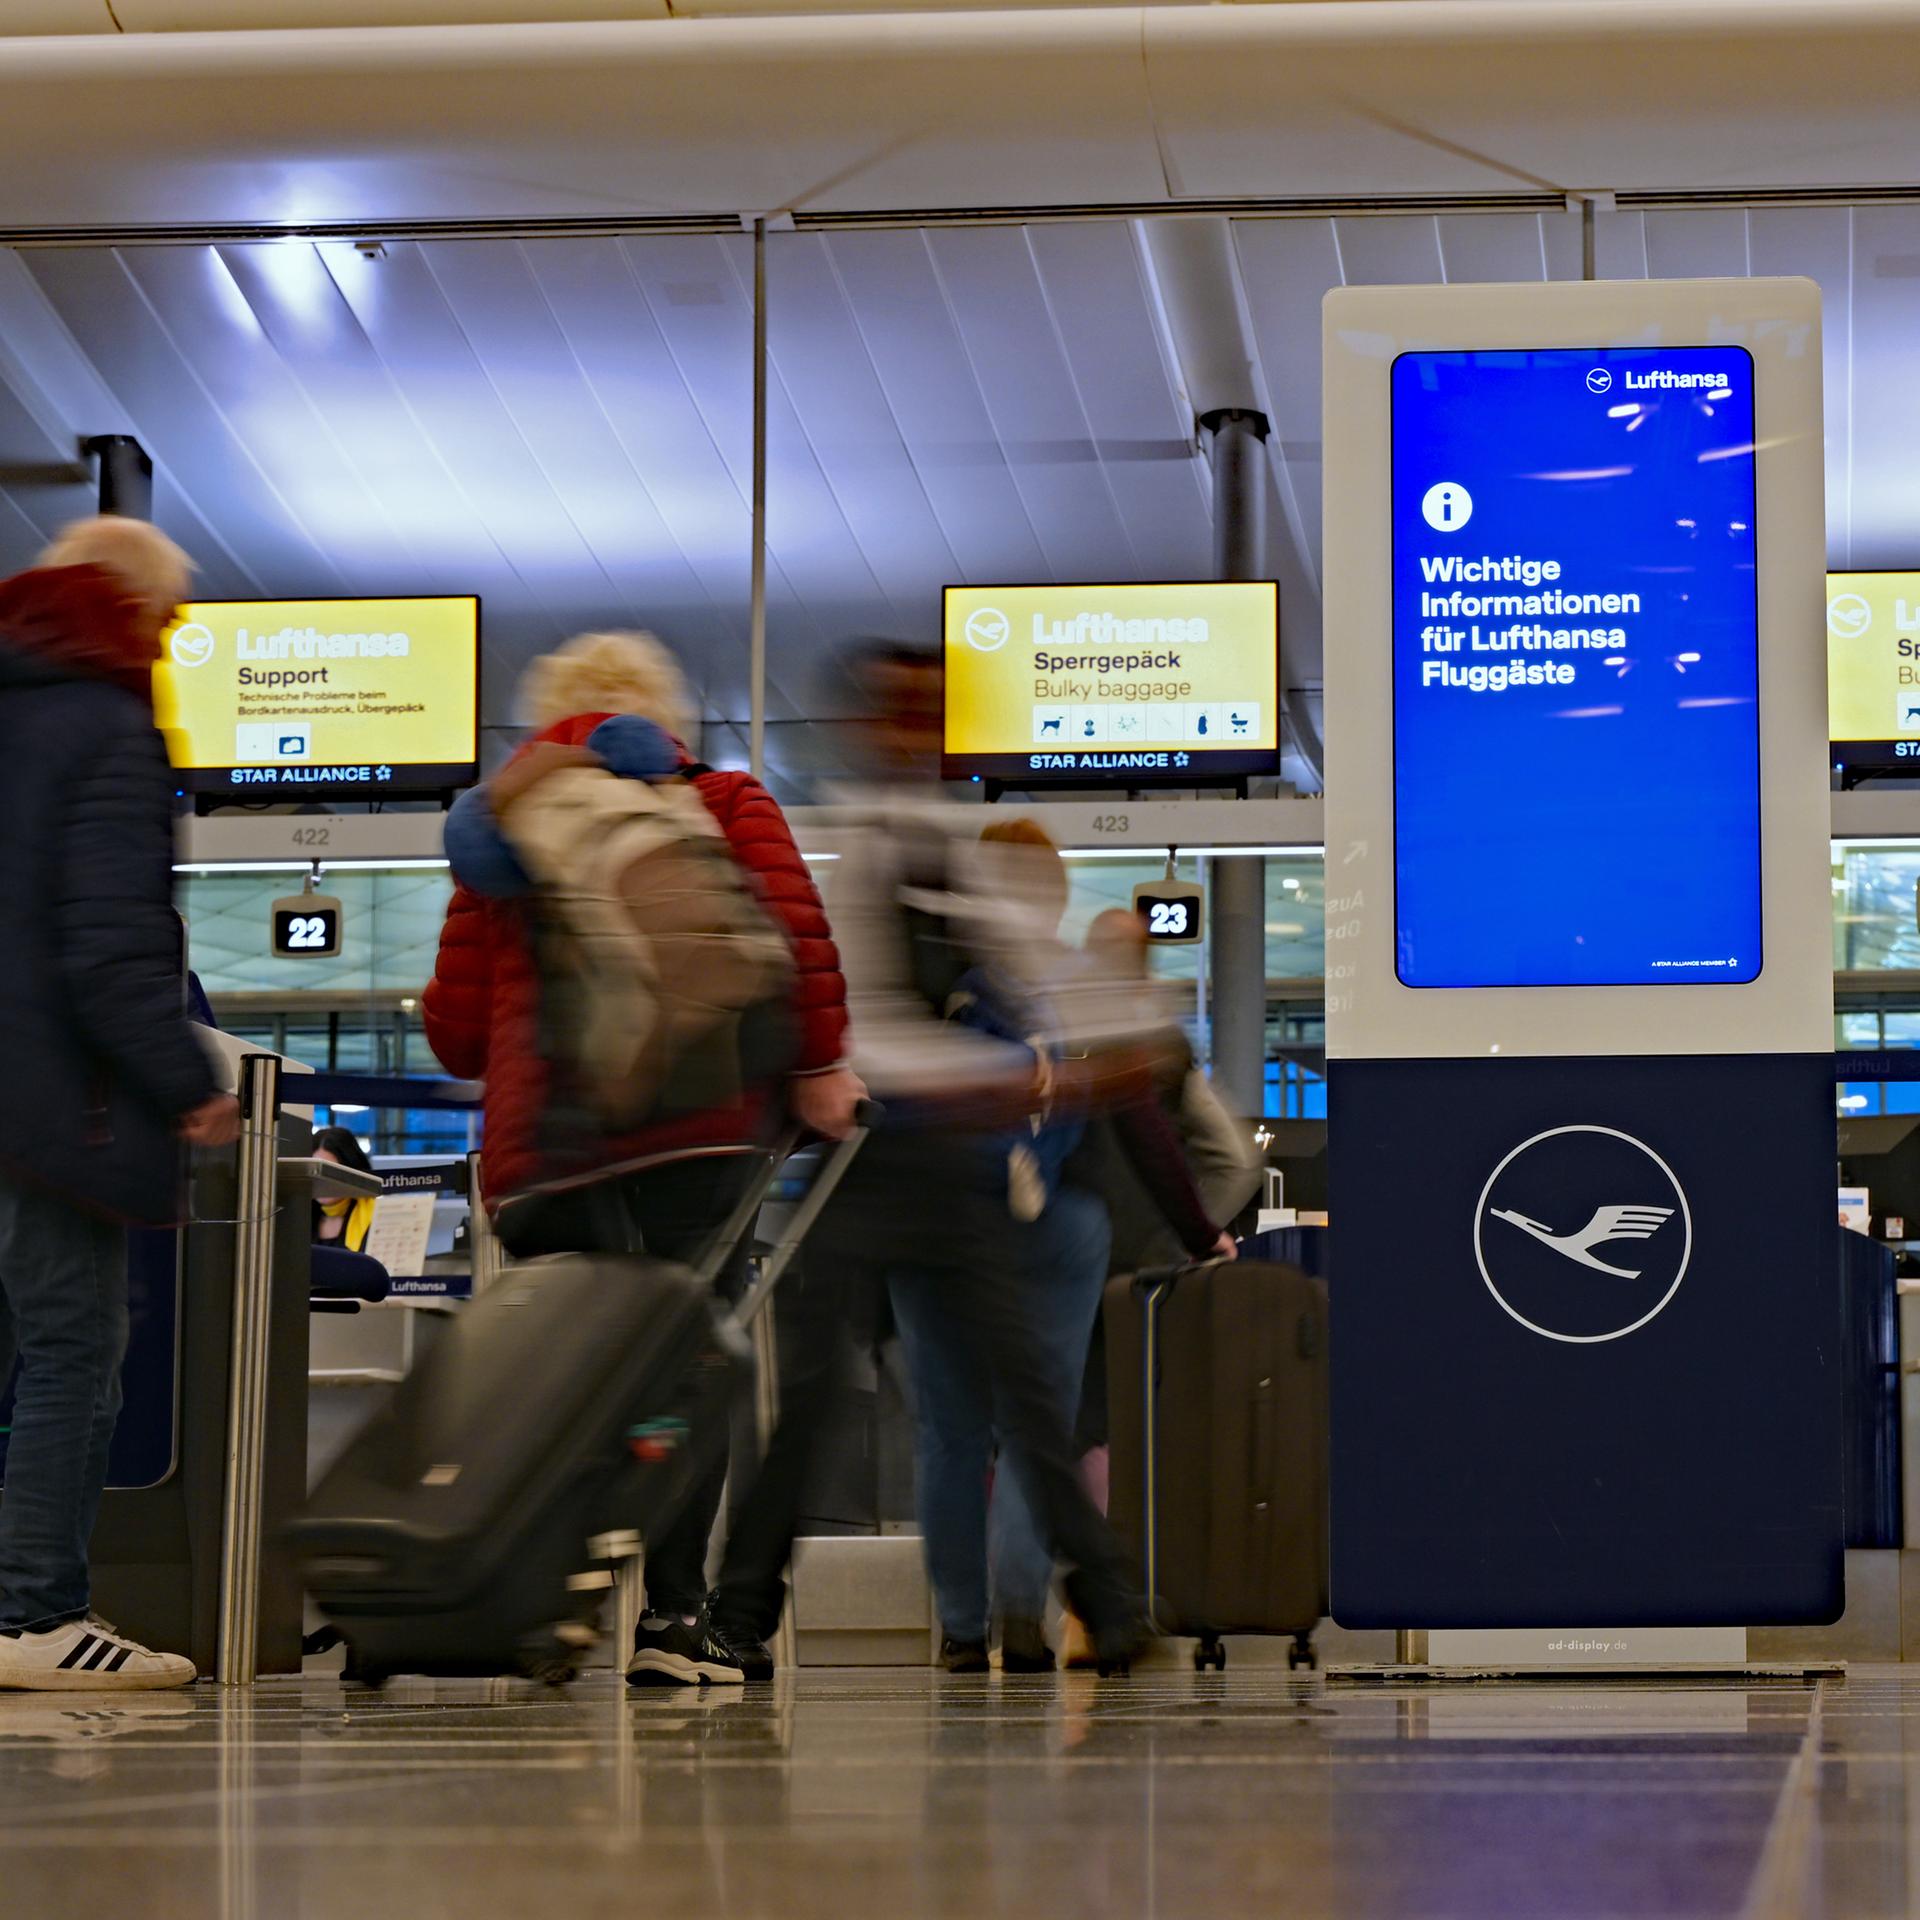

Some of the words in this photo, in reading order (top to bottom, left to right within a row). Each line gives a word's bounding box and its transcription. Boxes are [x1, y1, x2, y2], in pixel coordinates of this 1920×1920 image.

[1626, 370, 1728, 389] Lufthansa
[1420, 556, 1561, 586] Wichtige
[1421, 589, 1640, 617] Informationen
[1032, 612, 1209, 645] Lufthansa
[1421, 626, 1465, 652] für
[1472, 625, 1626, 651] Lufthansa
[236, 627, 410, 660] Lufthansa
[1034, 649, 1181, 674] Sperrgepäck
[238, 667, 329, 688] Support
[1422, 659, 1576, 692] Fluggäste
[238, 692, 300, 702] Technische
[302, 691, 356, 701] Probleme
[358, 690, 387, 700] beim
[1035, 679, 1092, 701] Bulky
[1098, 678, 1191, 701] baggage
[238, 704, 355, 716] Bordkartenausdruck,
[357, 702, 425, 716] Übergepäck
[1030, 753, 1076, 769] STAR
[1080, 752, 1169, 768] ALLIANCE
[231, 769, 277, 784] STAR
[281, 767, 371, 783] ALLIANCE
[1092, 815, 1129, 833] 423
[291, 827, 330, 846] 422
[1150, 903, 1188, 934] 23
[288, 917, 326, 948] 22
[381, 1174, 442, 1188] ufthansa
[391, 1280, 447, 1292] Lufthansa
[1548, 1639, 1628, 1653] ad-display.de
